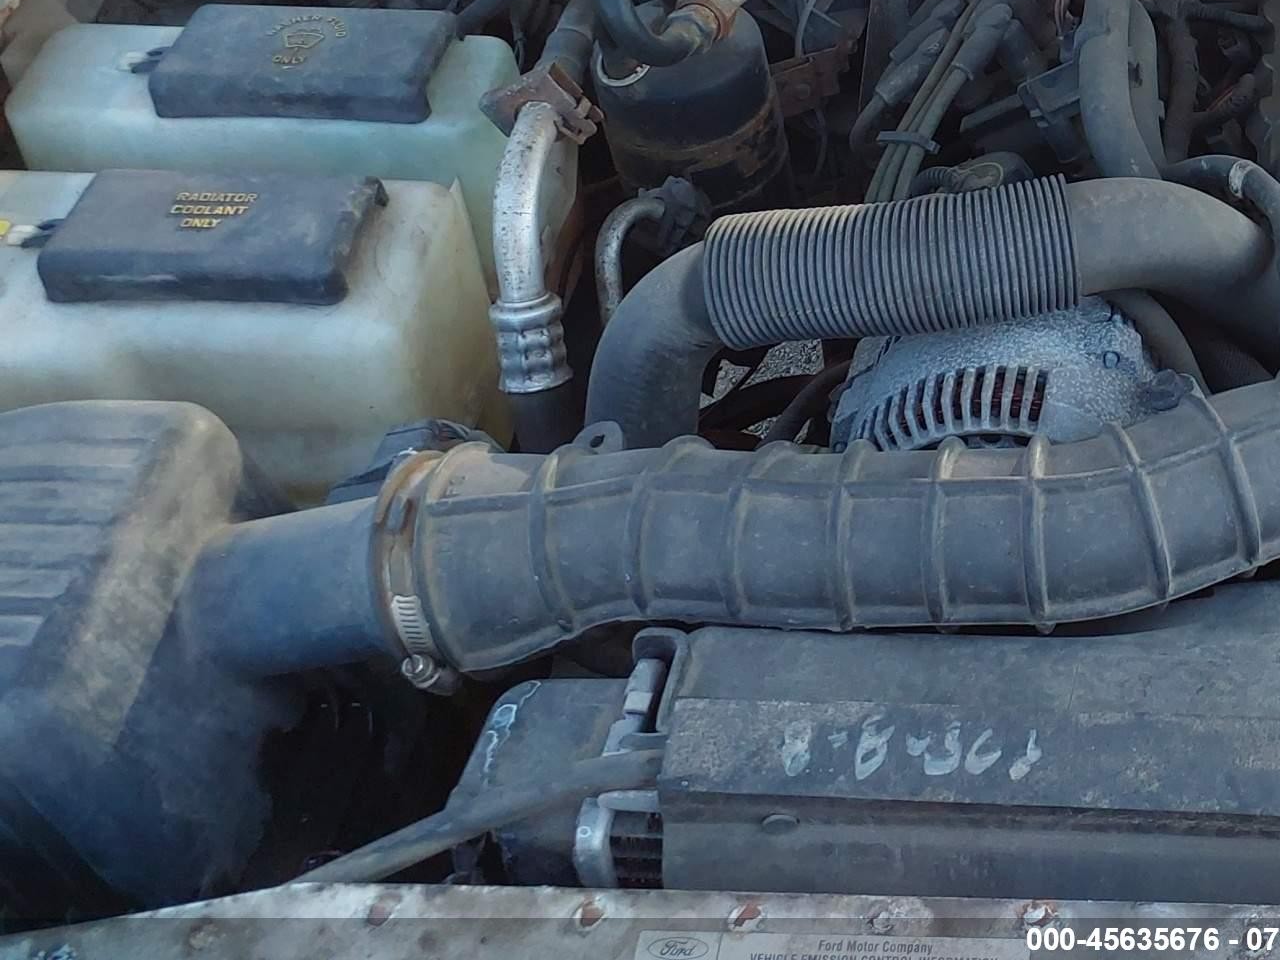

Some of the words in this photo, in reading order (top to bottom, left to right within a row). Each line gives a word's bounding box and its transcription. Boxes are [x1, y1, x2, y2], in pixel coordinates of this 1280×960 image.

[272, 55, 305, 64] ONLY
[175, 191, 258, 203] RADIATOR
[169, 204, 249, 215] COOLANT
[179, 217, 222, 228] ONLY
[659, 939, 697, 957] Ford
[818, 939, 843, 951] Ford
[847, 940, 879, 952] Motor
[882, 940, 933, 955] Company
